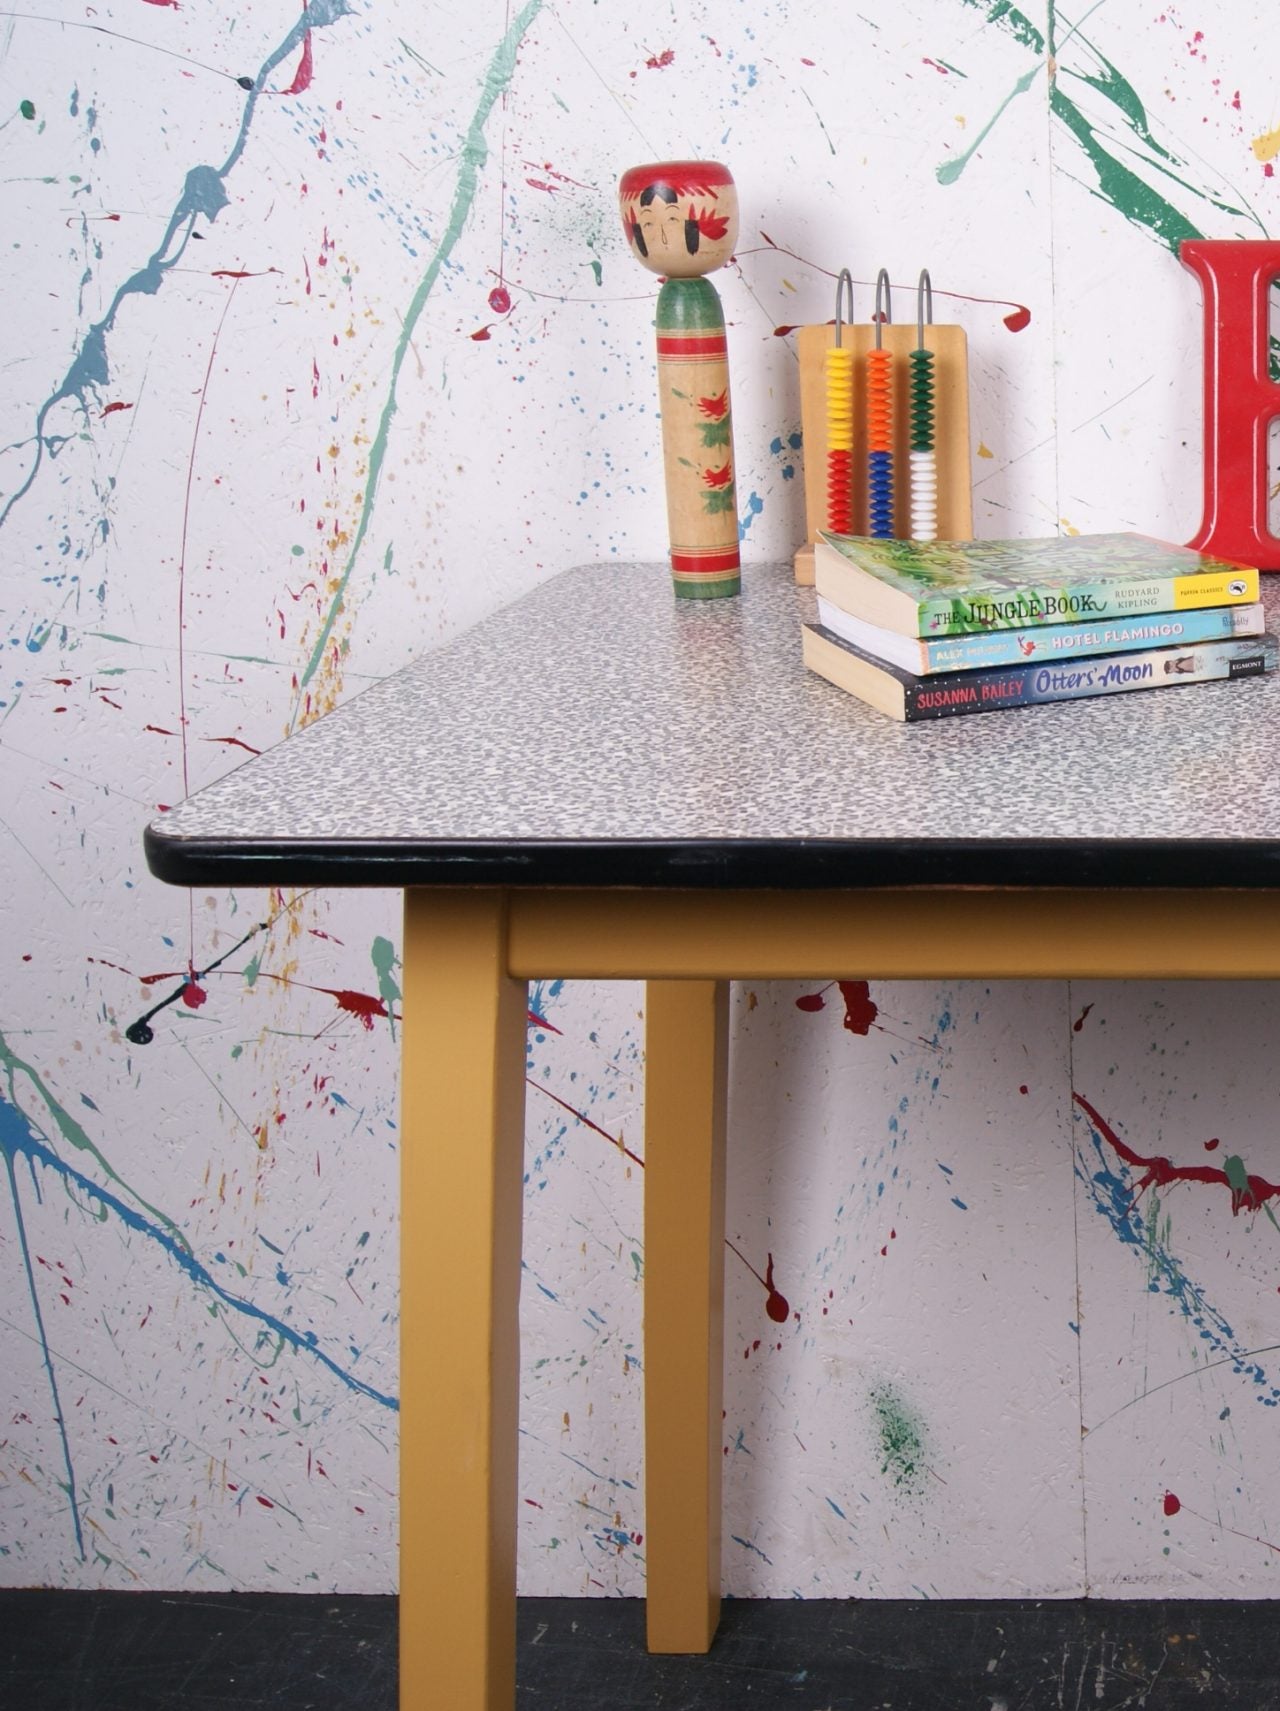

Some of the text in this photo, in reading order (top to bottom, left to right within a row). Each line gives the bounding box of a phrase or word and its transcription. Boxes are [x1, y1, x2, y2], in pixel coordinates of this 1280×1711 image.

[1115, 586, 1160, 598] RUDYARD
[1200, 586, 1223, 594] CLASSICS
[934, 594, 1107, 625] THE JUNGLE BOOK
[1118, 598, 1158, 609] KIPLING
[1052, 623, 1184, 649] HOTEL FLAMINGO
[1098, 662, 1153, 688] Moon
[1232, 660, 1261, 671] EGMONT
[917, 679, 1024, 709] SUSANNA BAILEY
